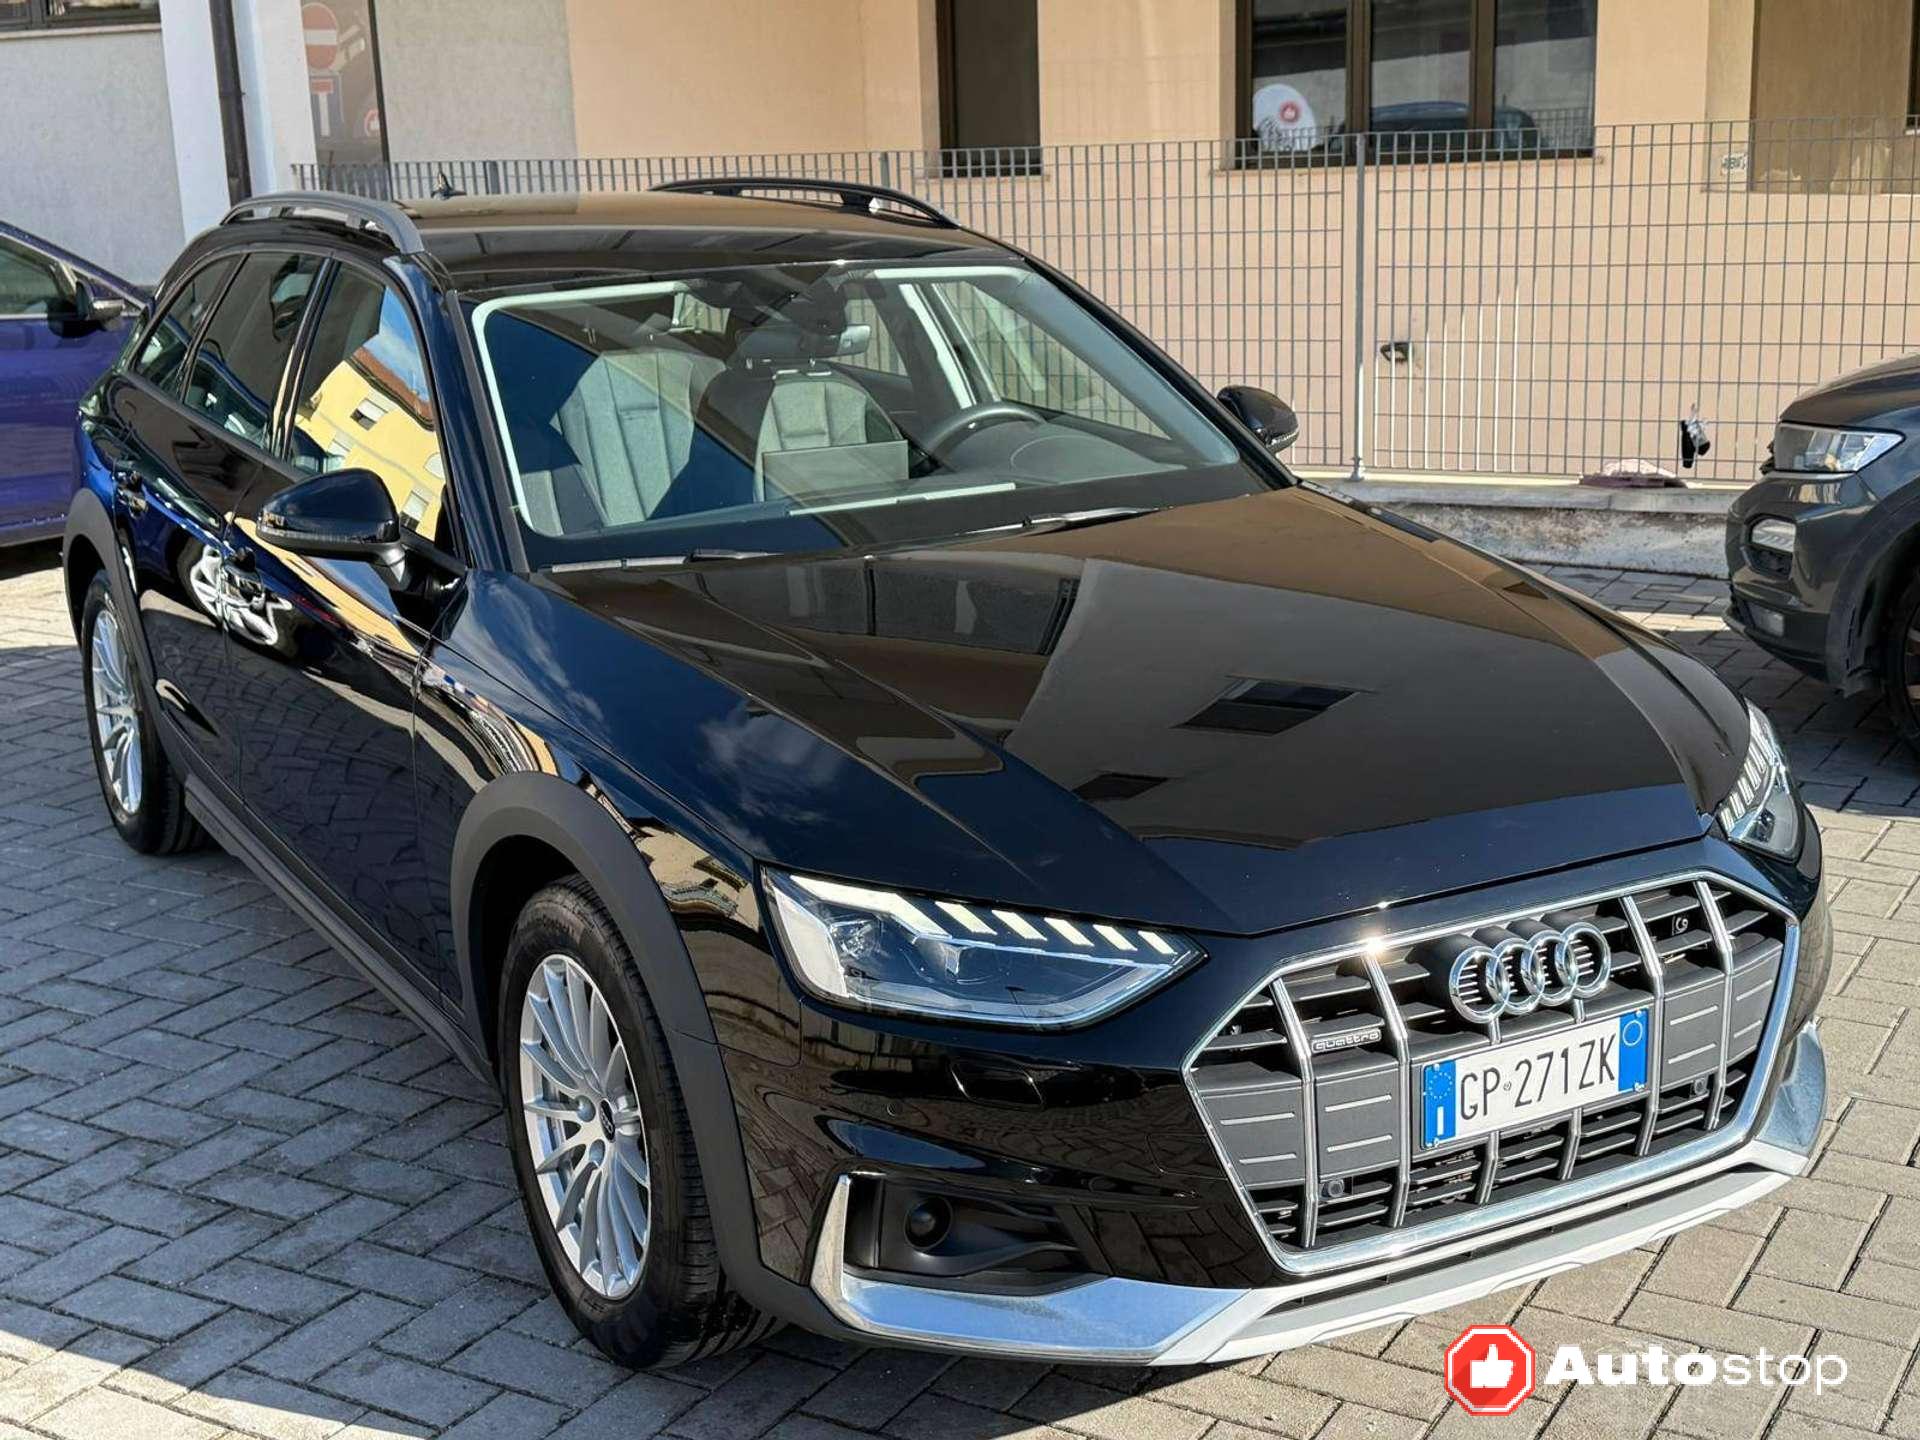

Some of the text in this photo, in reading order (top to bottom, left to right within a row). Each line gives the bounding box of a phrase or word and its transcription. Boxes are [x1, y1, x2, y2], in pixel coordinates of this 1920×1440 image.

[1314, 1031, 1379, 1051] quattro
[1460, 1033, 1617, 1120] GP 271ZK
[1436, 1105, 1445, 1136] I
